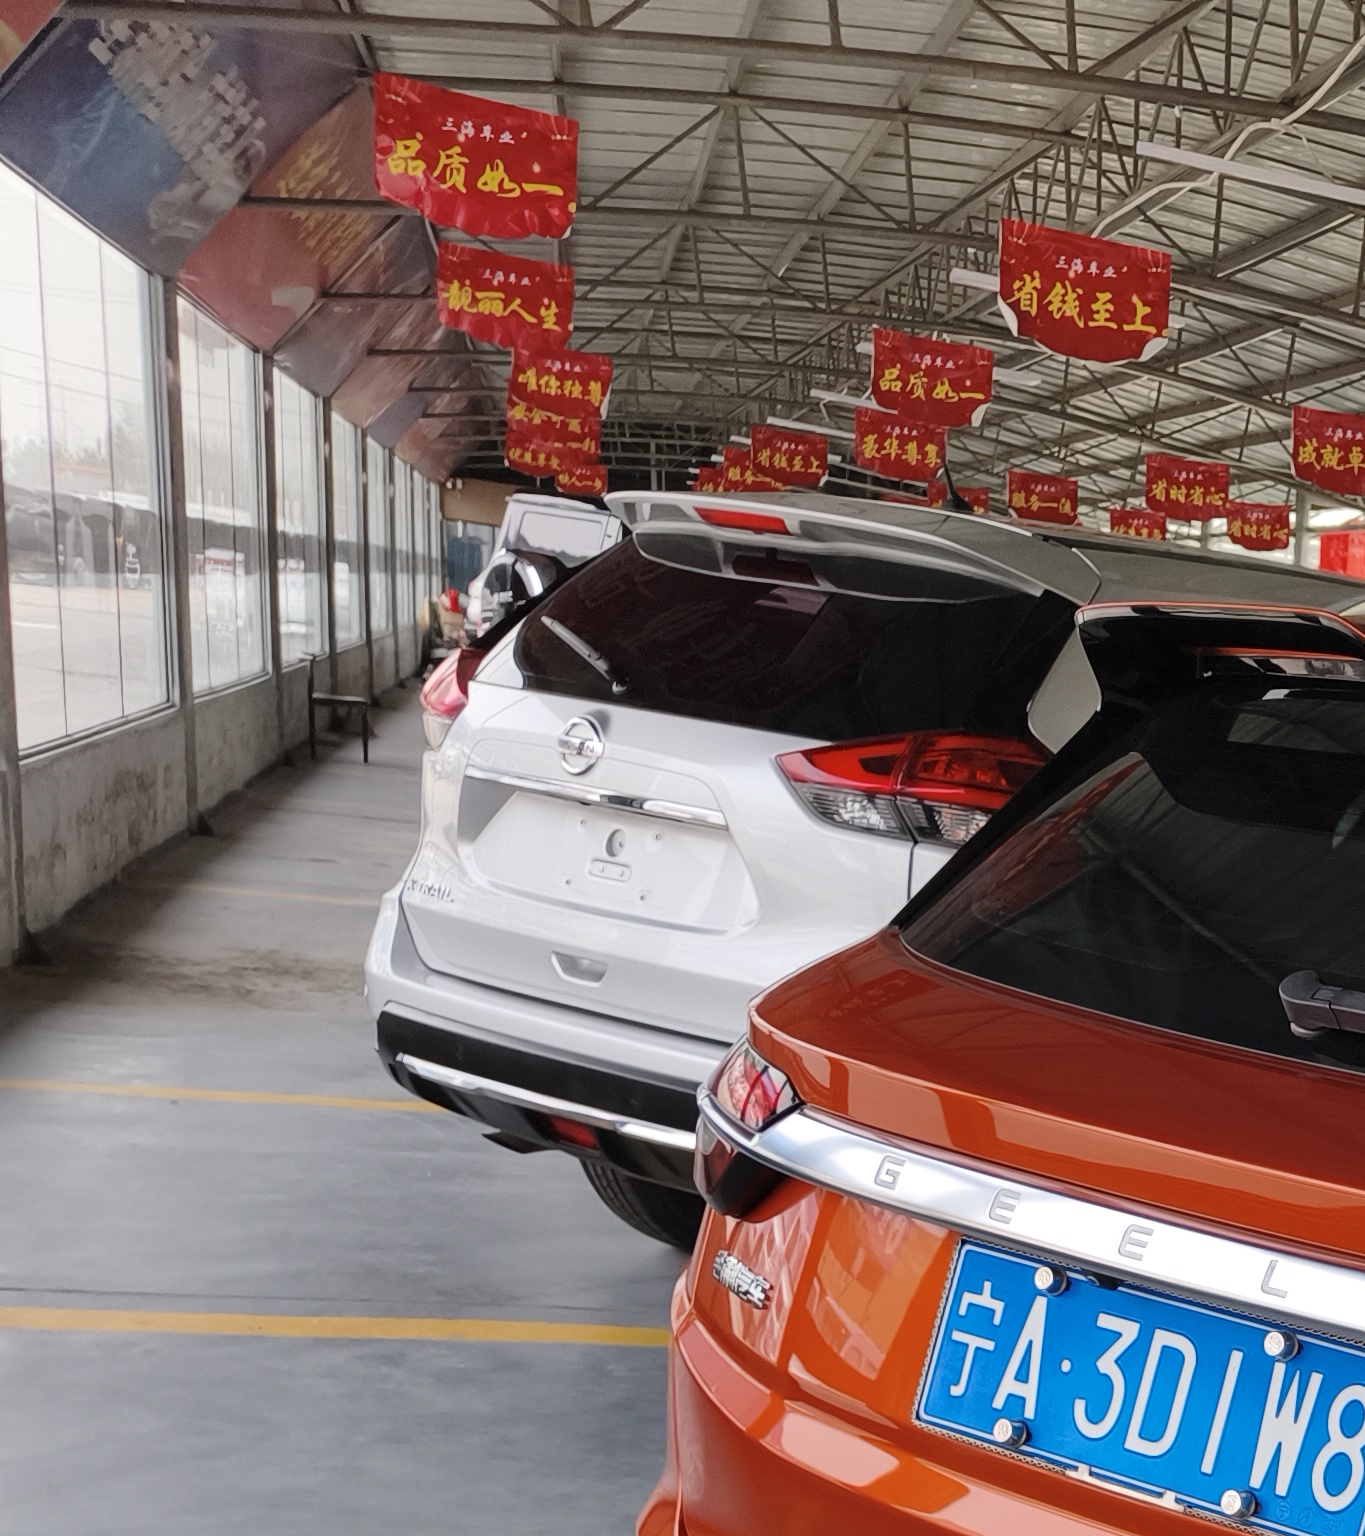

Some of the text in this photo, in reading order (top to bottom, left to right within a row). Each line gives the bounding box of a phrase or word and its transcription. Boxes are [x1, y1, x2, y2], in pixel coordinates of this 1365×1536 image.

[387, 138, 564, 198] 品质如一
[1006, 272, 1157, 334] 省钱至上
[879, 367, 985, 402] 品质如一
